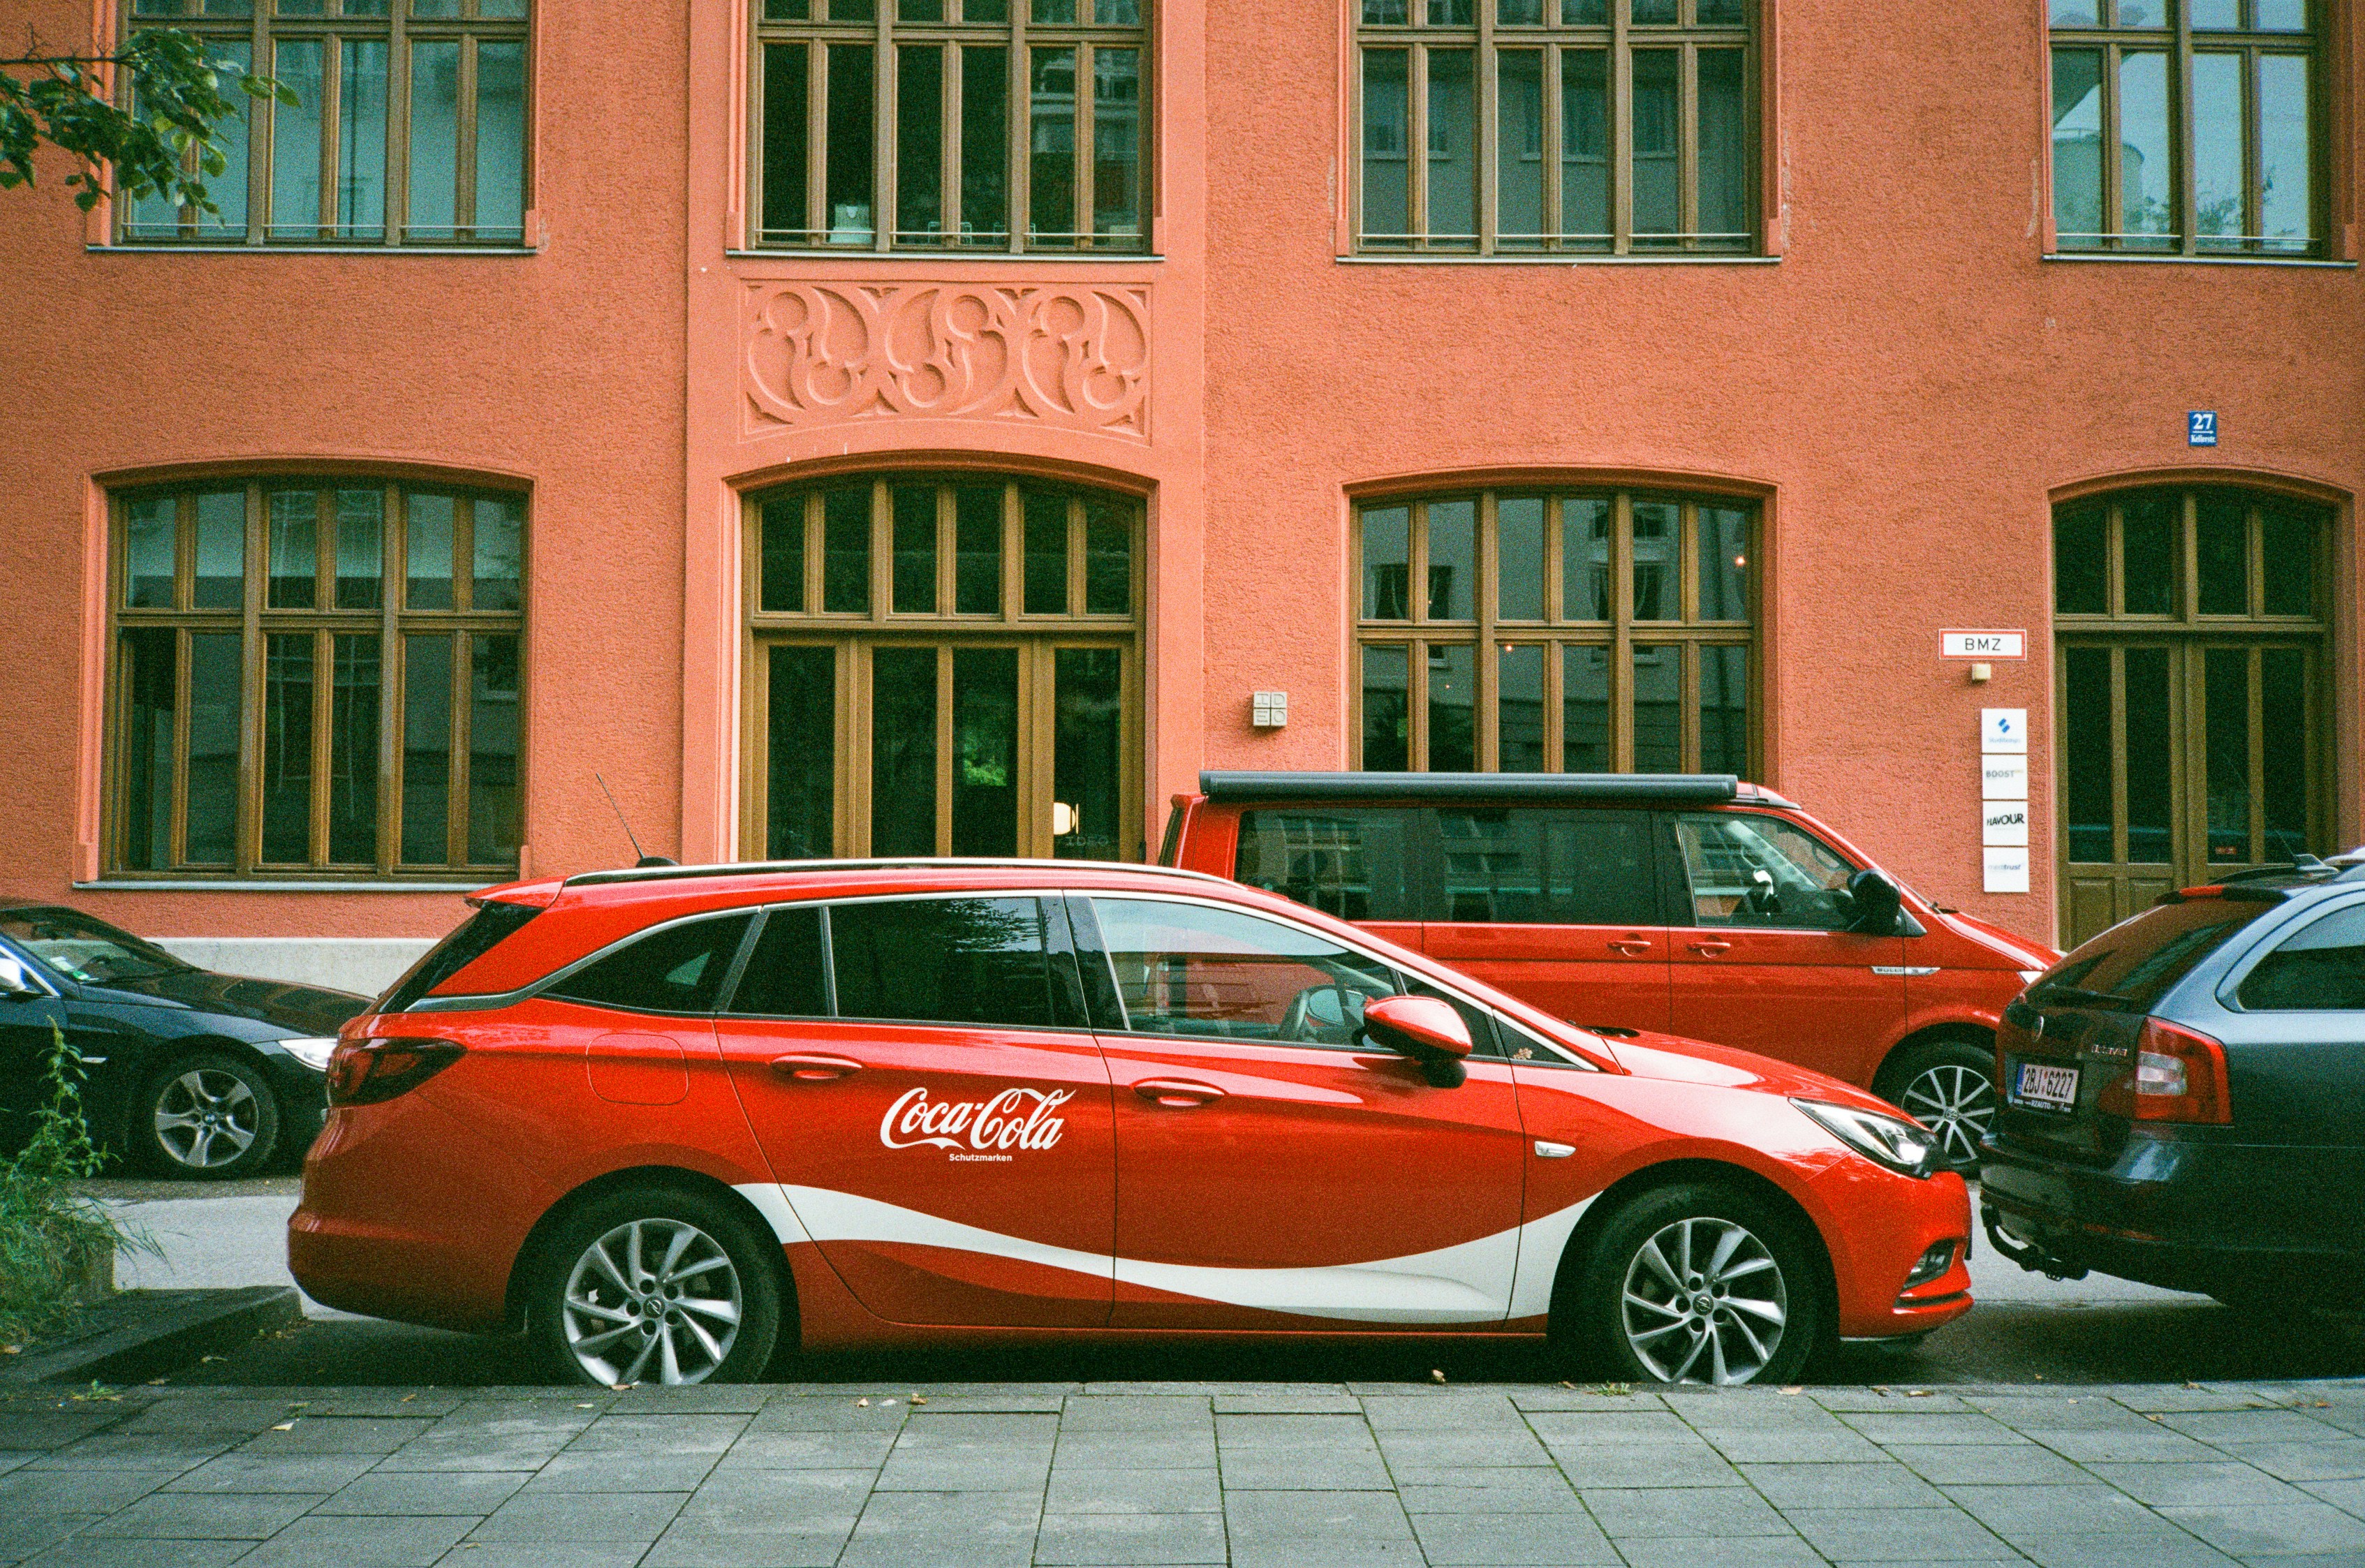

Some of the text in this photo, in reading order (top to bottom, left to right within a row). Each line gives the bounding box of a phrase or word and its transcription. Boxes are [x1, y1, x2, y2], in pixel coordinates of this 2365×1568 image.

[2193, 413, 2213, 429] 27
[1965, 638, 2001, 651] BMZ
[2024, 1067, 2074, 1099] 2BJ 6227
[880, 1087, 1076, 1151] Coca-Cola
[949, 1153, 1012, 1162] Schutzmarken
